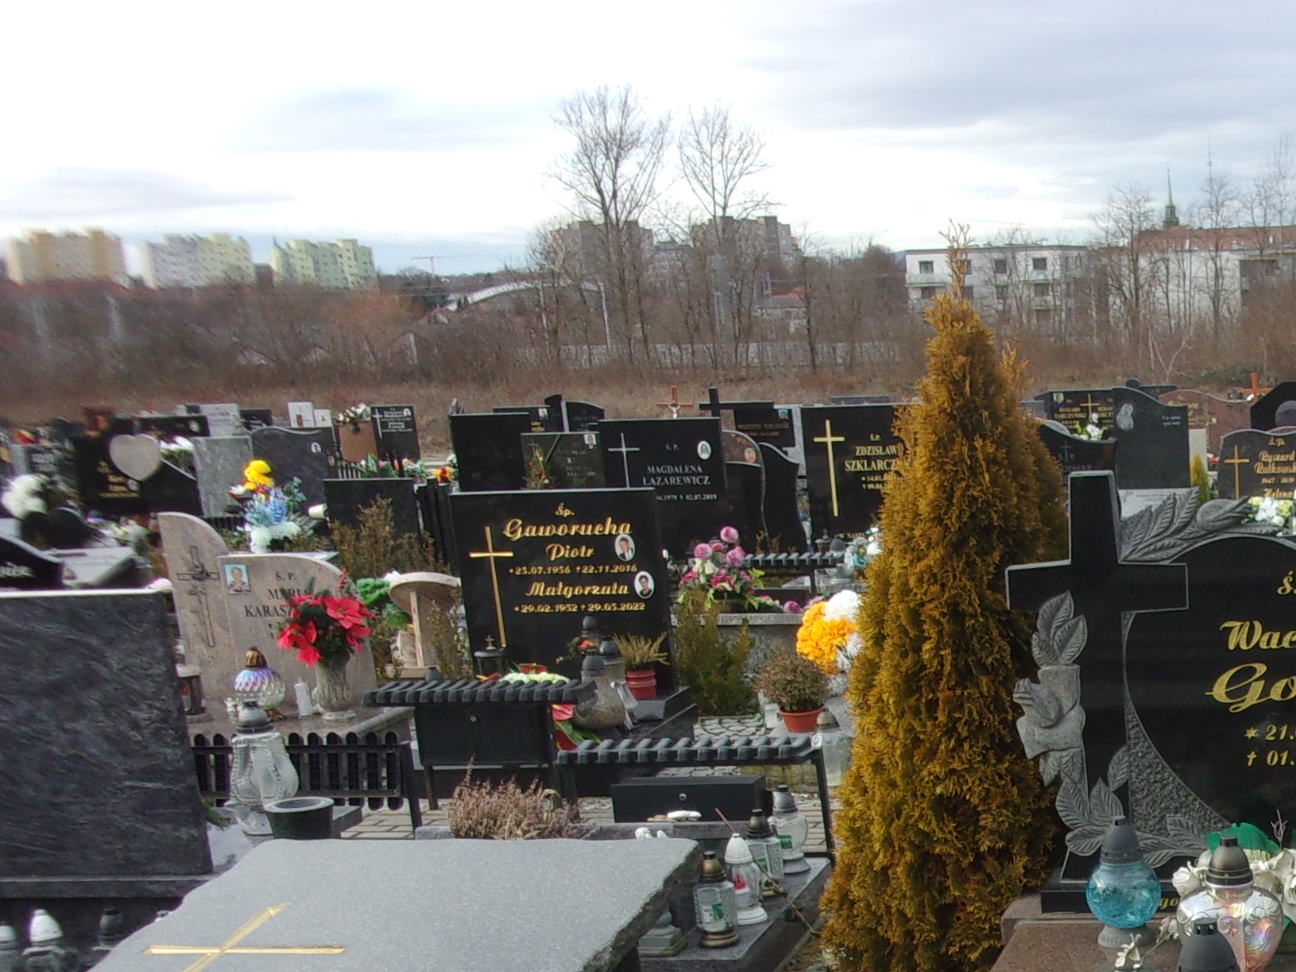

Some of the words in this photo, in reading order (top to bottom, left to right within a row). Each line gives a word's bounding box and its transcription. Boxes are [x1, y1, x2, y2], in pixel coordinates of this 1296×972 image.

[646, 465, 703, 474] MAGDALENA
[844, 459, 900, 471] SZKLARCZ
[502, 516, 633, 542] Gaworucha
[545, 543, 596, 561] Piotr
[525, 581, 629, 599] Małgorzata
